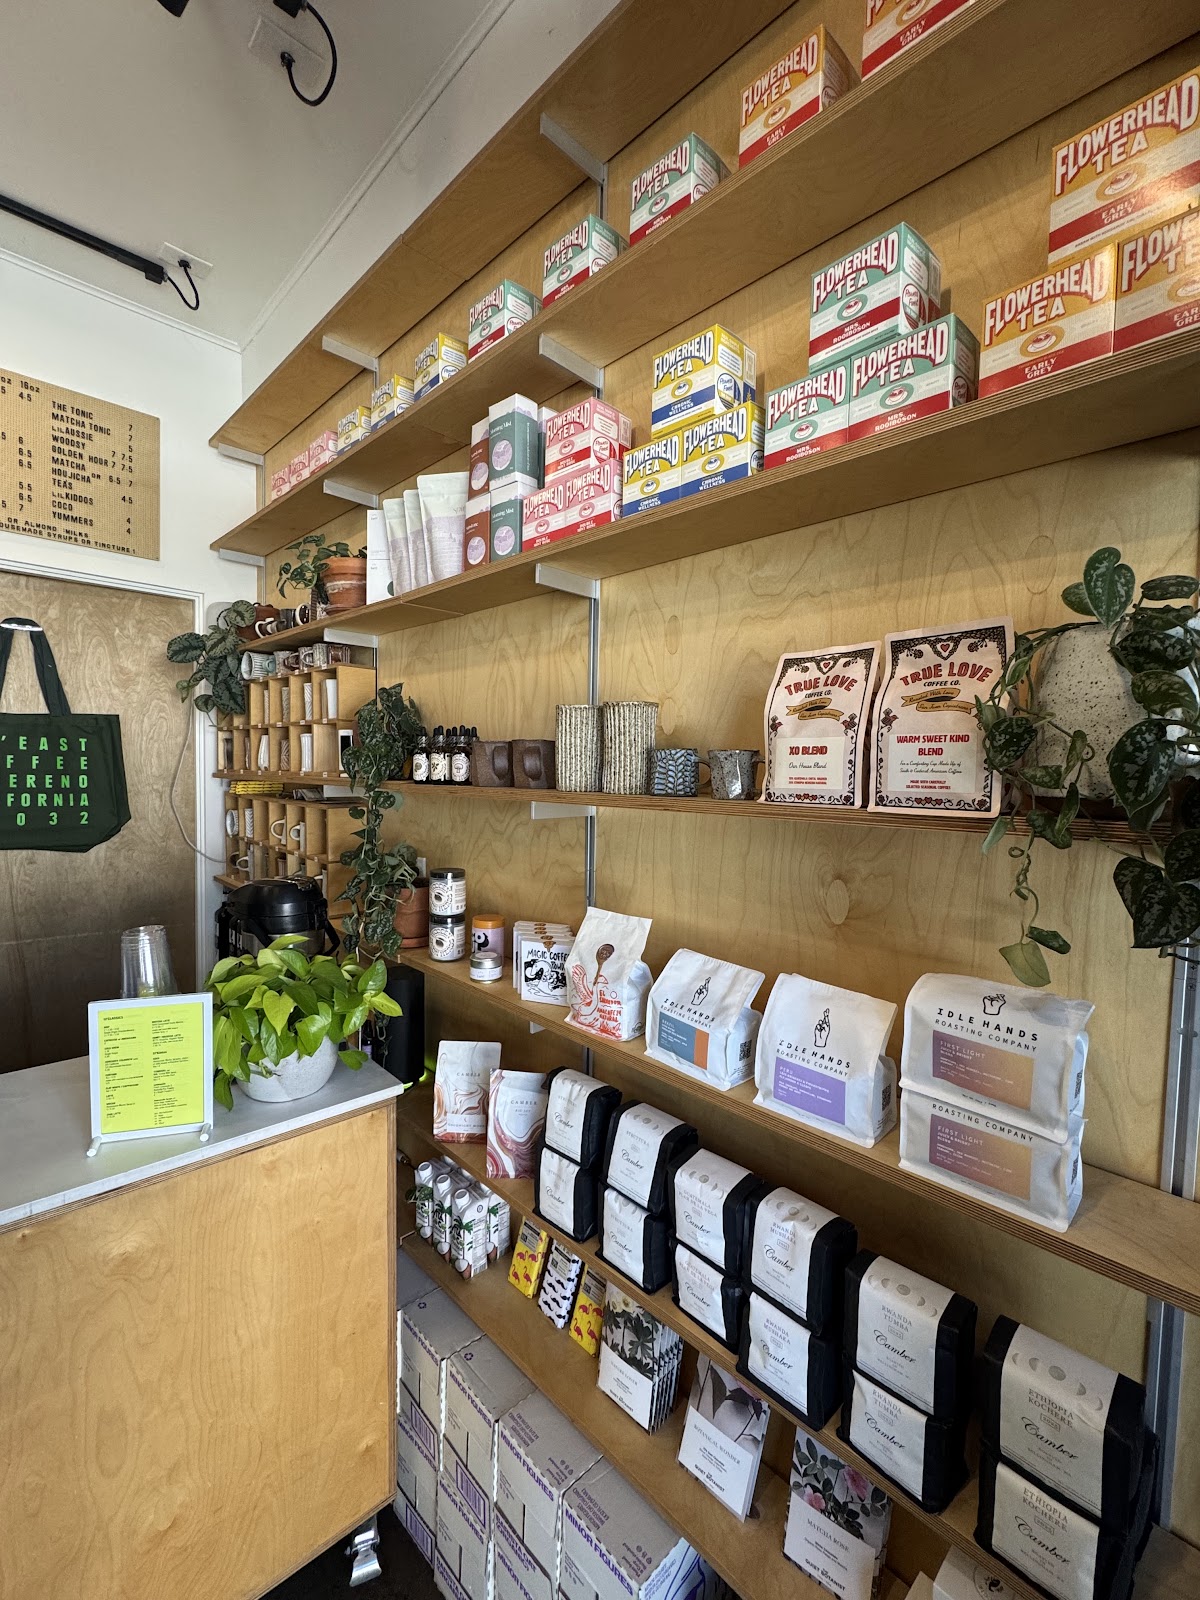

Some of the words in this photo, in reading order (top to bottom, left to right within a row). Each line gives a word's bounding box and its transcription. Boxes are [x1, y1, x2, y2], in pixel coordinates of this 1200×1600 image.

[741, 33, 818, 127] FLOWERHEAD
[761, 75, 791, 108] TEA
[1054, 74, 1200, 196] FLOWERHEAD
[1091, 129, 1149, 174] TEA
[631, 140, 690, 211] FLOWERHEAD
[646, 173, 669, 199] TEA
[1101, 199, 1138, 219] EARLY
[1104, 208, 1135, 224] GREY
[544, 220, 589, 278] FLOWERHEAD
[556, 247, 573, 268] TEA
[812, 231, 899, 313] FLOWERHEAD
[833, 269, 869, 300] TEA
[984, 251, 1110, 347] FLOWERHEAD
[478, 307, 492, 325] TEA
[1016, 295, 1066, 332] TEA
[654, 330, 714, 389] FLOWERHEAD
[669, 360, 693, 381] TEA
[852, 321, 950, 398] FLOWERHEAD
[1024, 357, 1057, 374] EARLY
[876, 358, 915, 387] TEA
[1026, 365, 1054, 379] GREY
[767, 366, 846, 431] FLOWERHEAD
[787, 398, 819, 421] TEA
[52, 401, 67, 413] THE
[71, 406, 94, 420] TONIC
[52, 412, 86, 430] MATCHA
[89, 422, 111, 436] TONIC
[128, 424, 133, 432] 7
[546, 402, 591, 447] FLOWERHEAD
[557, 427, 575, 441] TEA
[683, 407, 747, 462] FLOWERHEAD
[18, 436, 23, 444] 6
[52, 434, 86, 450] WOODSY
[699, 433, 725, 456] TEA
[18, 447, 32, 458] 6.5
[18, 459, 32, 469] 6.5
[52, 445, 84, 460] GOLDEN
[88, 455, 109, 467] HOUR
[52, 456, 86, 472] MATCHA
[624, 435, 679, 484] FLOWERHEAD
[52, 467, 91, 484] HOUJICHA
[111, 461, 116, 469] 7
[638, 459, 660, 479] TEA
[18, 481, 32, 491] 5.5
[109, 475, 121, 485] 6.5
[128, 480, 133, 488] 7
[566, 464, 611, 507] FLOWERHEAD
[18, 492, 32, 503] 6.5
[52, 500, 73, 512] COCO
[523, 484, 564, 524] FLOWERHEAD
[577, 487, 595, 503] TEA
[18, 504, 24, 512] 7
[52, 511, 94, 527] YUMMERS
[533, 505, 550, 519] TEA
[24, 520, 57, 532] ALMOND
[65, 529, 89, 538] MILKS
[126, 517, 131, 525] 4
[126, 527, 131, 535] 4
[47, 531, 79, 543] SYRUPS
[81, 538, 91, 546] OR
[94, 541, 131, 553] TINCTURE
[784, 677, 820, 696] TRUE
[823, 674, 858, 692] LOVE
[900, 663, 942, 687] TRUE
[947, 661, 993, 684] LOVE
[789, 746, 801, 755] XO
[801, 745, 828, 755] BLEND
[896, 735, 921, 744] WARM
[922, 735, 948, 743] SWEET
[949, 734, 970, 743] KIND
[918, 747, 944, 756] BLEND
[526, 948, 547, 960] MAGIC
[660, 1004, 686, 1019] ROASTING
[687, 1016, 711, 1029] COMPANY
[664, 998, 685, 1010] IDLE
[686, 1007, 716, 1022] HANDS
[935, 1018, 983, 1037] ROASTING
[988, 1033, 1038, 1053] COMPANY
[937, 1007, 975, 1025] IDLE
[982, 1019, 1039, 1042] HANDS
[778, 1039, 807, 1055] IDLE
[811, 1050, 851, 1069] HANDS
[940, 1040, 960, 1051] FIRST
[962, 1048, 986, 1059] LIGHT
[776, 1048, 811, 1065] ROASTING
[813, 1061, 849, 1077] COMPANY
[932, 1103, 981, 1124] ROASTING
[985, 1120, 1034, 1143] COMPANY
[937, 1125, 959, 1137] FIRST
[961, 1134, 984, 1146] LIGHT
[683, 1210, 711, 1235] Camber
[763, 1244, 795, 1273] Camber
[881, 1304, 913, 1327] RWANDA
[883, 1313, 910, 1334] TUMBA
[760, 1339, 794, 1370] Camber
[873, 1329, 917, 1365] Camber
[1028, 1388, 1074, 1420] ETHIOPIA
[1028, 1396, 1073, 1428] KOCHERE
[864, 1411, 906, 1450] Camber
[1021, 1416, 1079, 1460] Camber
[500, 1430, 522, 1463] MINOR
[522, 1459, 554, 1501] FIGURES
[1022, 1496, 1068, 1532] KOCHERE
[1023, 1486, 1068, 1524] ETHIOPIA
[1014, 1515, 1071, 1565] Camber
[565, 1508, 593, 1547] MINOR
[593, 1543, 634, 1596] FIGURES
